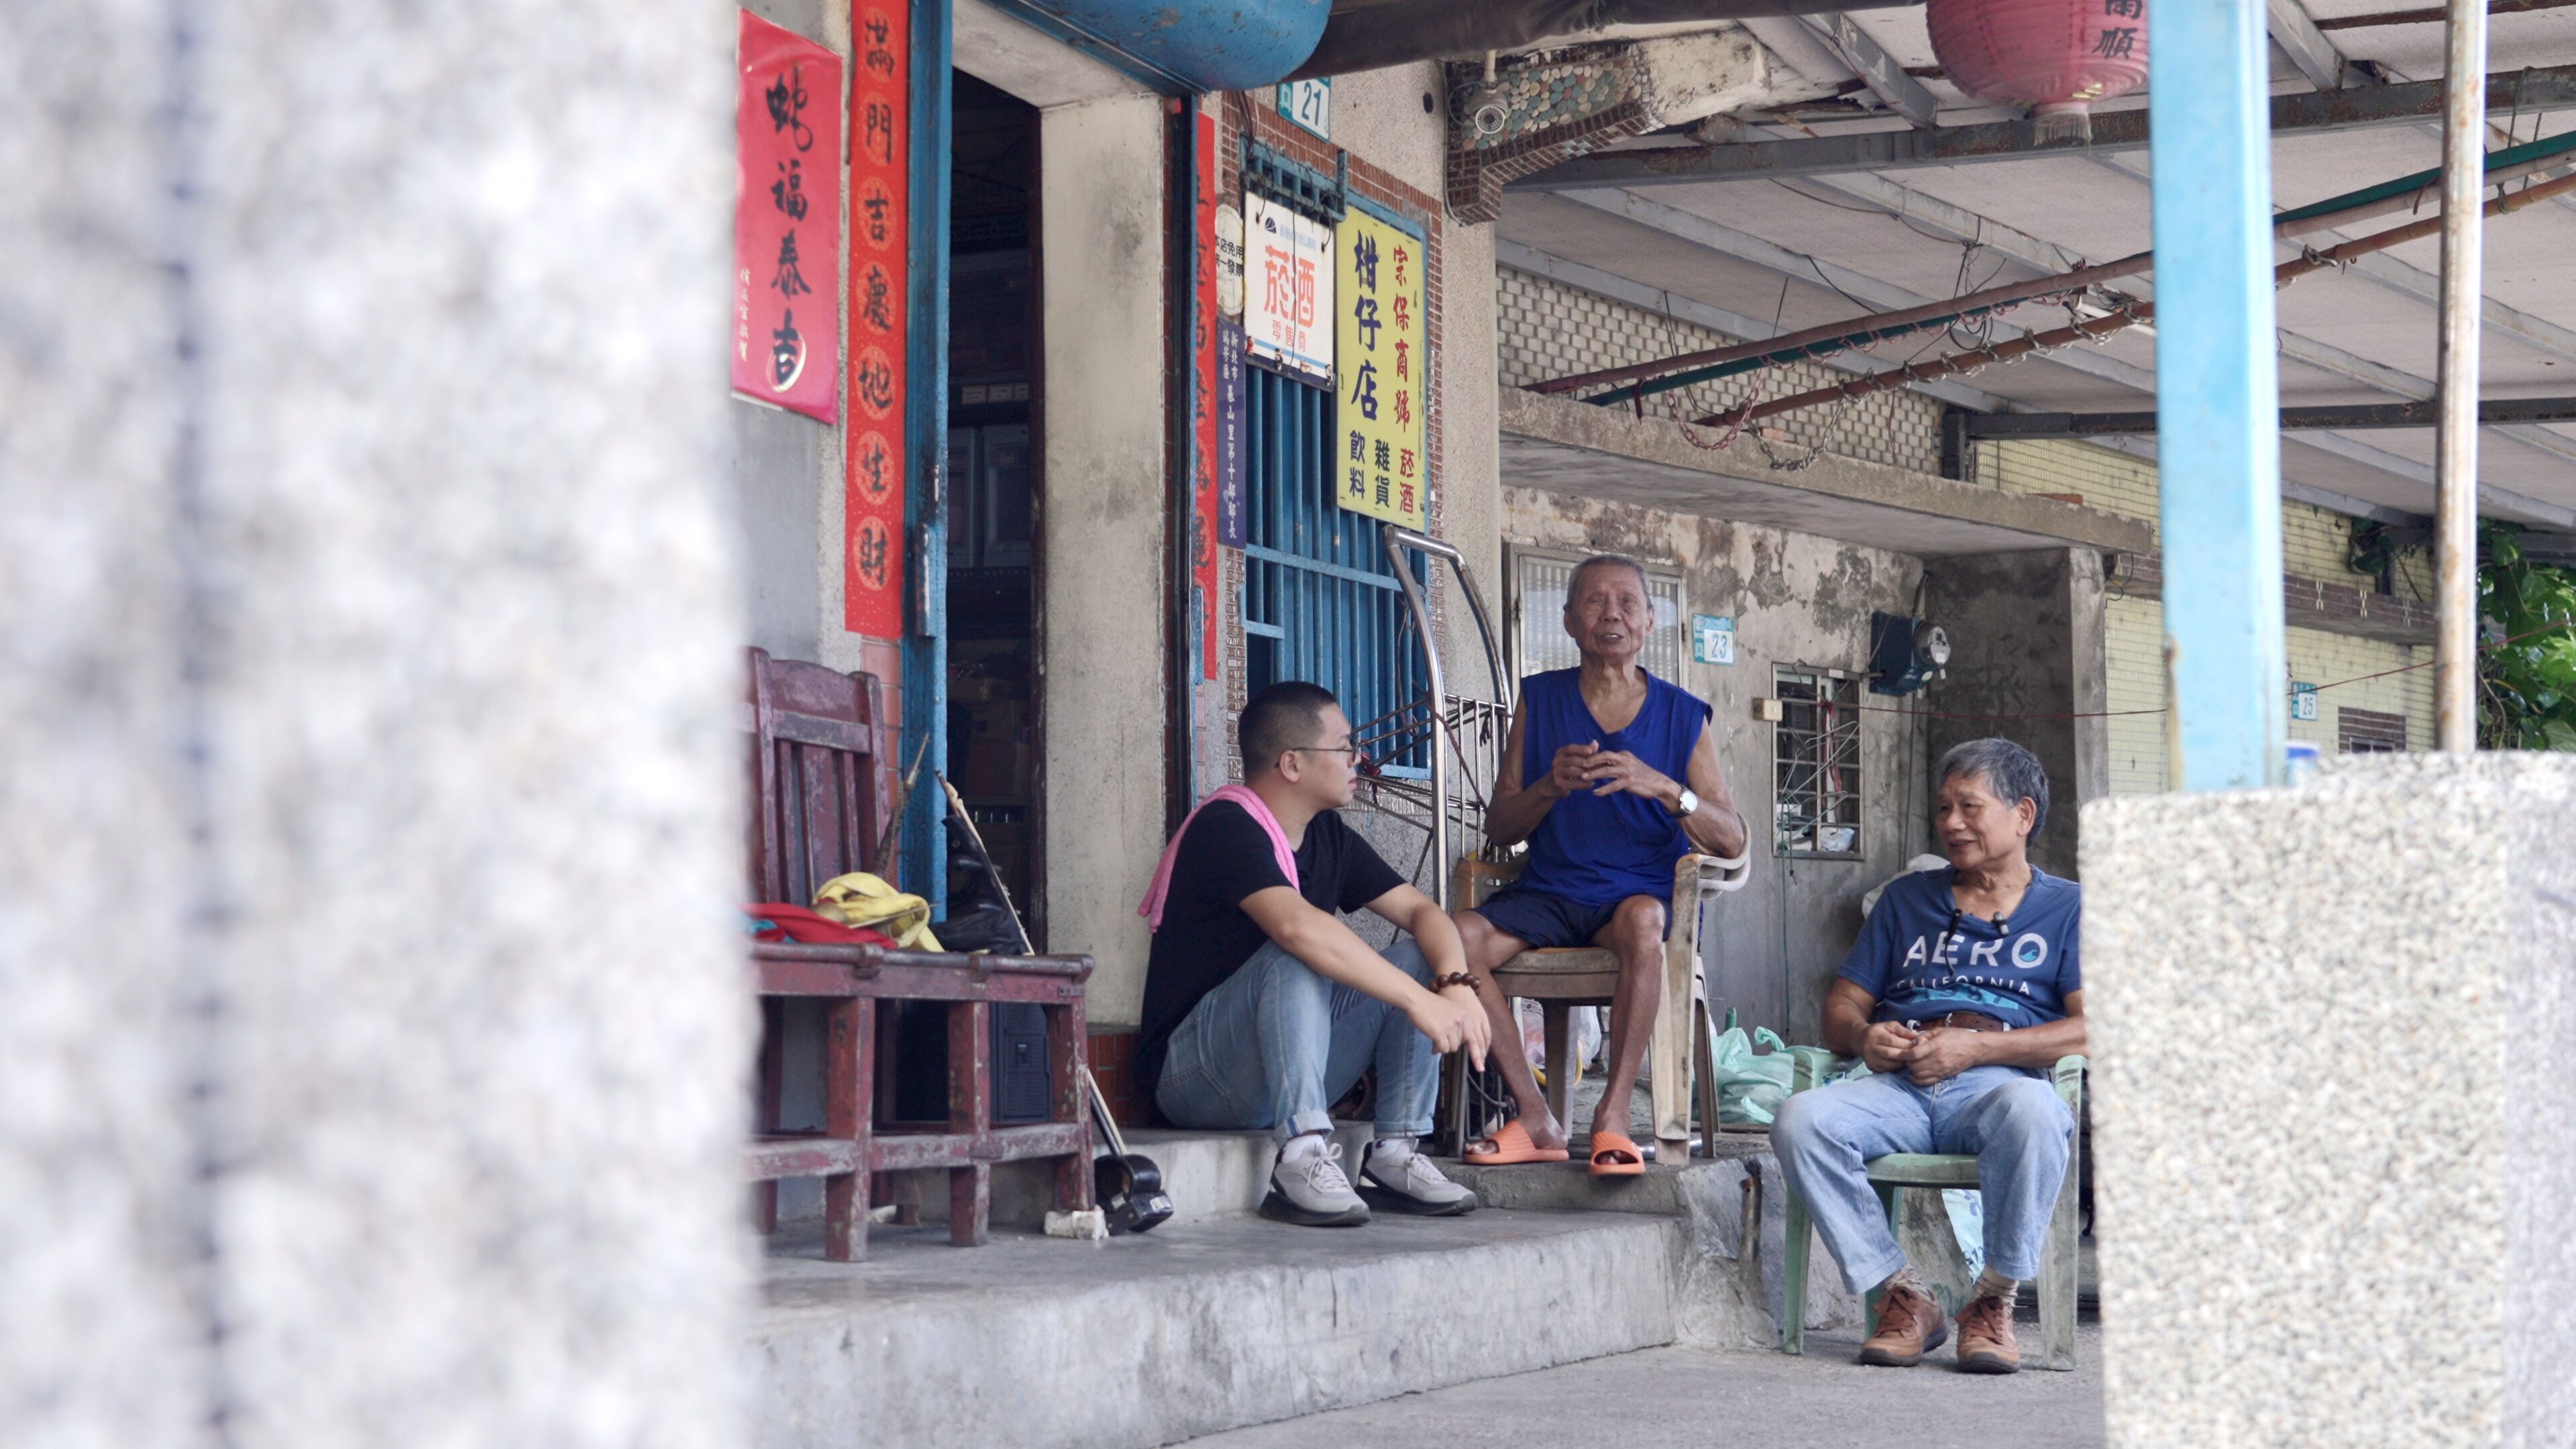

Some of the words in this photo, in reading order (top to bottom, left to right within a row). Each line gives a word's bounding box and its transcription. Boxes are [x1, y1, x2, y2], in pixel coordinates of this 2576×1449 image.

[1301, 81, 1321, 126] 21
[1264, 244, 1315, 328] 菸酒
[1272, 319, 1306, 352] 零售商
[1351, 229, 1382, 421] 柑仔店
[1350, 430, 1365, 499] 飲料
[1375, 439, 1390, 508] 雜貨
[1399, 447, 1414, 514] 菸酒
[1711, 634, 1727, 659] 23
[2303, 697, 2313, 716] 25
[1902, 931, 2048, 969] AERO
